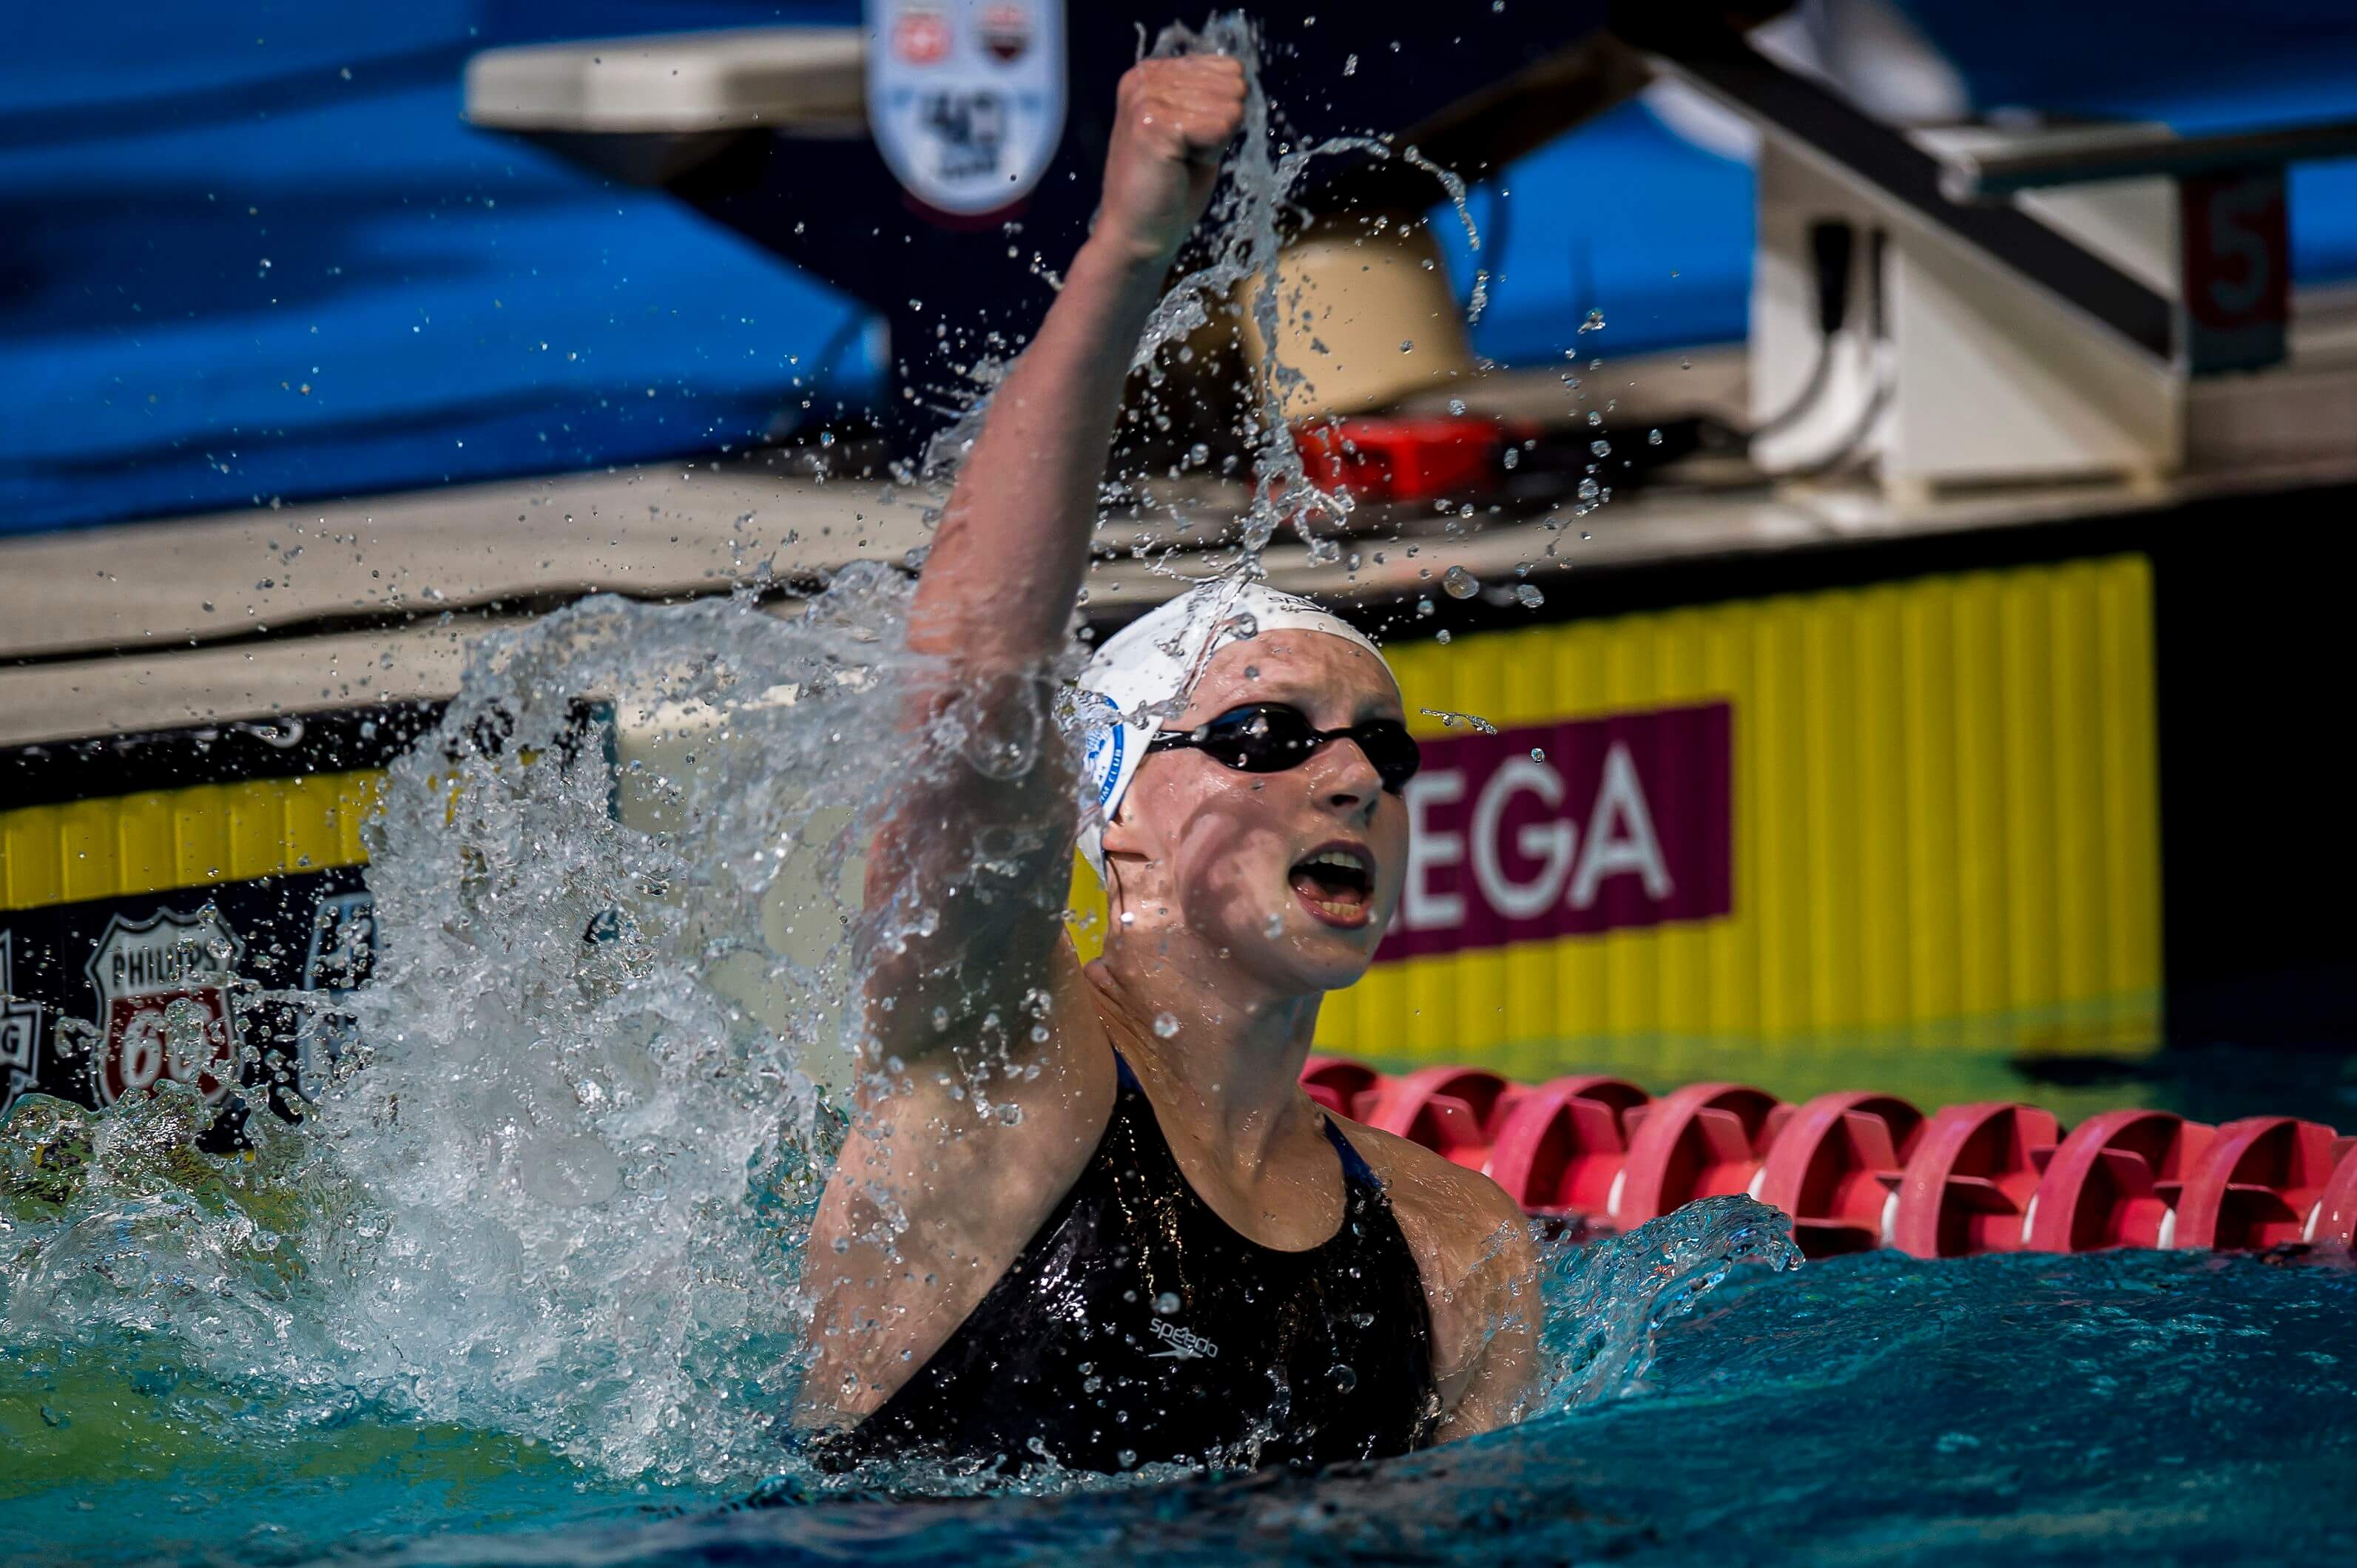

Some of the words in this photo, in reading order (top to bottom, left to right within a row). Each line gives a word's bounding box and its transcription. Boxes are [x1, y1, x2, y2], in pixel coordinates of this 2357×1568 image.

[2208, 180, 2279, 314] 5
[1388, 740, 1675, 935] EGA
[1148, 1317, 1219, 1359] speedo
